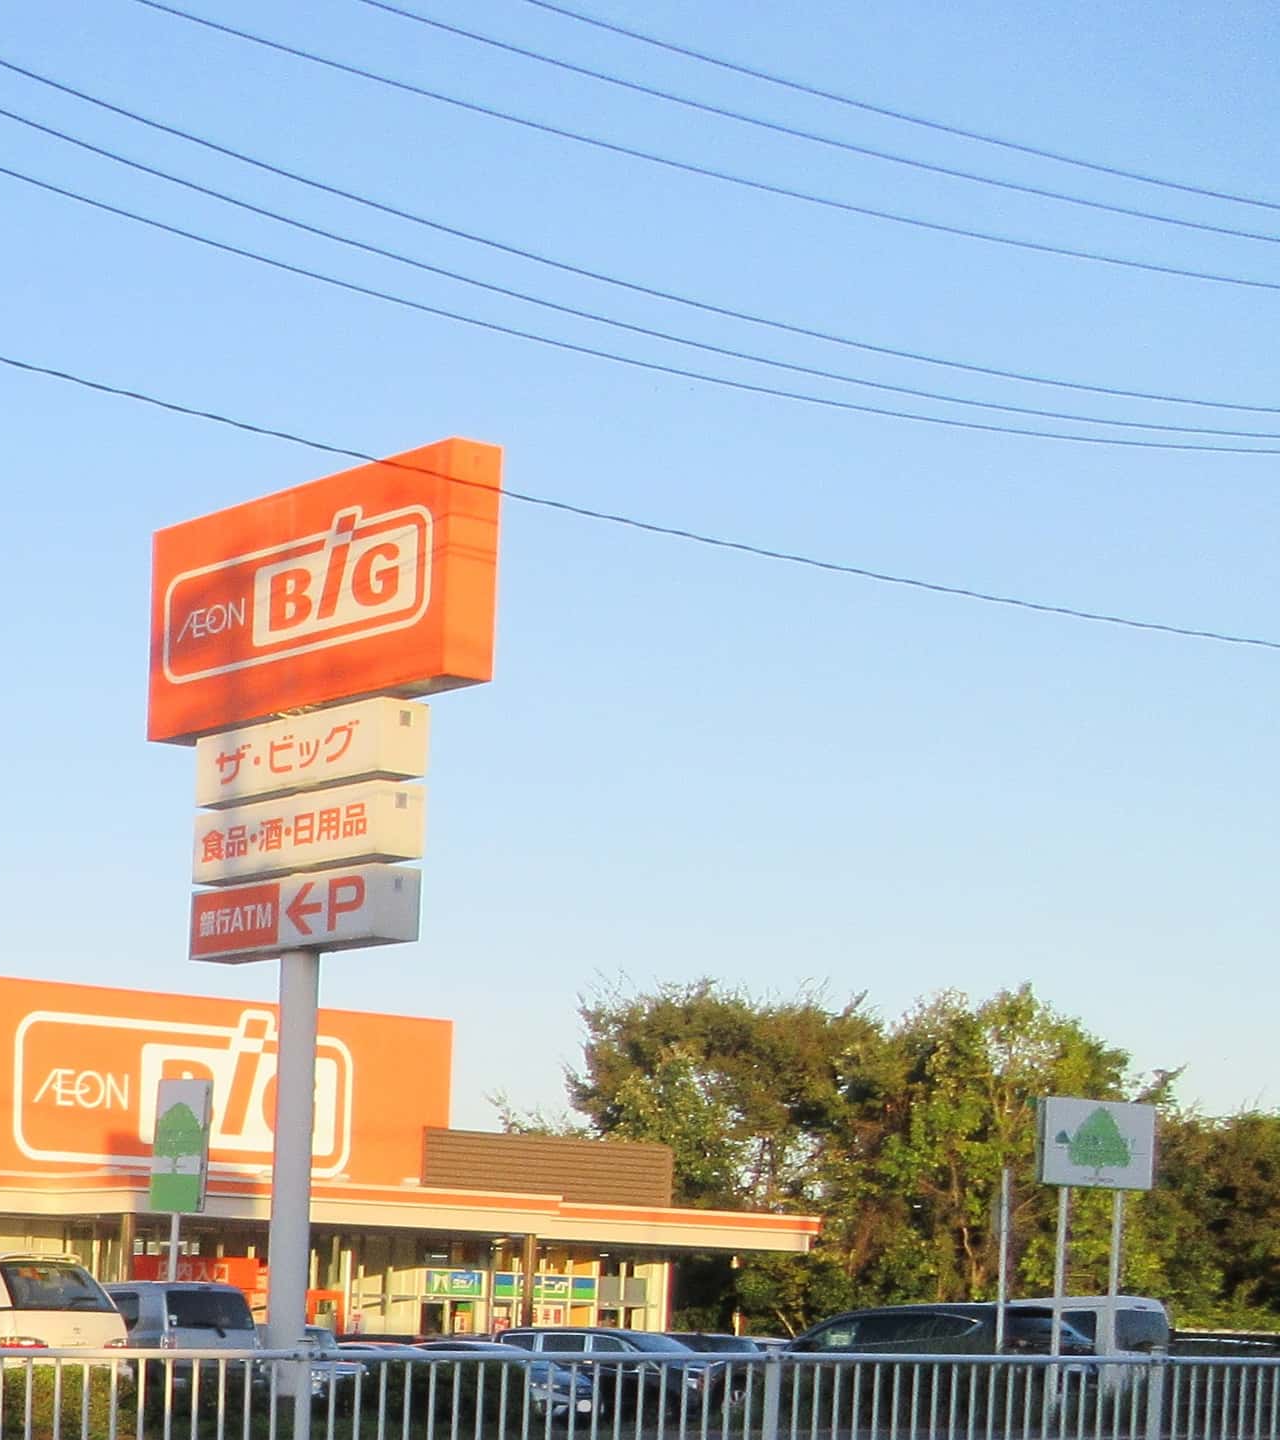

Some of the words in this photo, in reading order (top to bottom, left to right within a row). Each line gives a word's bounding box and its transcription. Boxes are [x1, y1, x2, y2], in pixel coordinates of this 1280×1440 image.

[215, 719, 360, 785] ザ・ビッグ
[200, 803, 367, 863] 食品・酒・日用品
[199, 903, 273, 938] 銀行ATM
[327, 875, 365, 932] P
